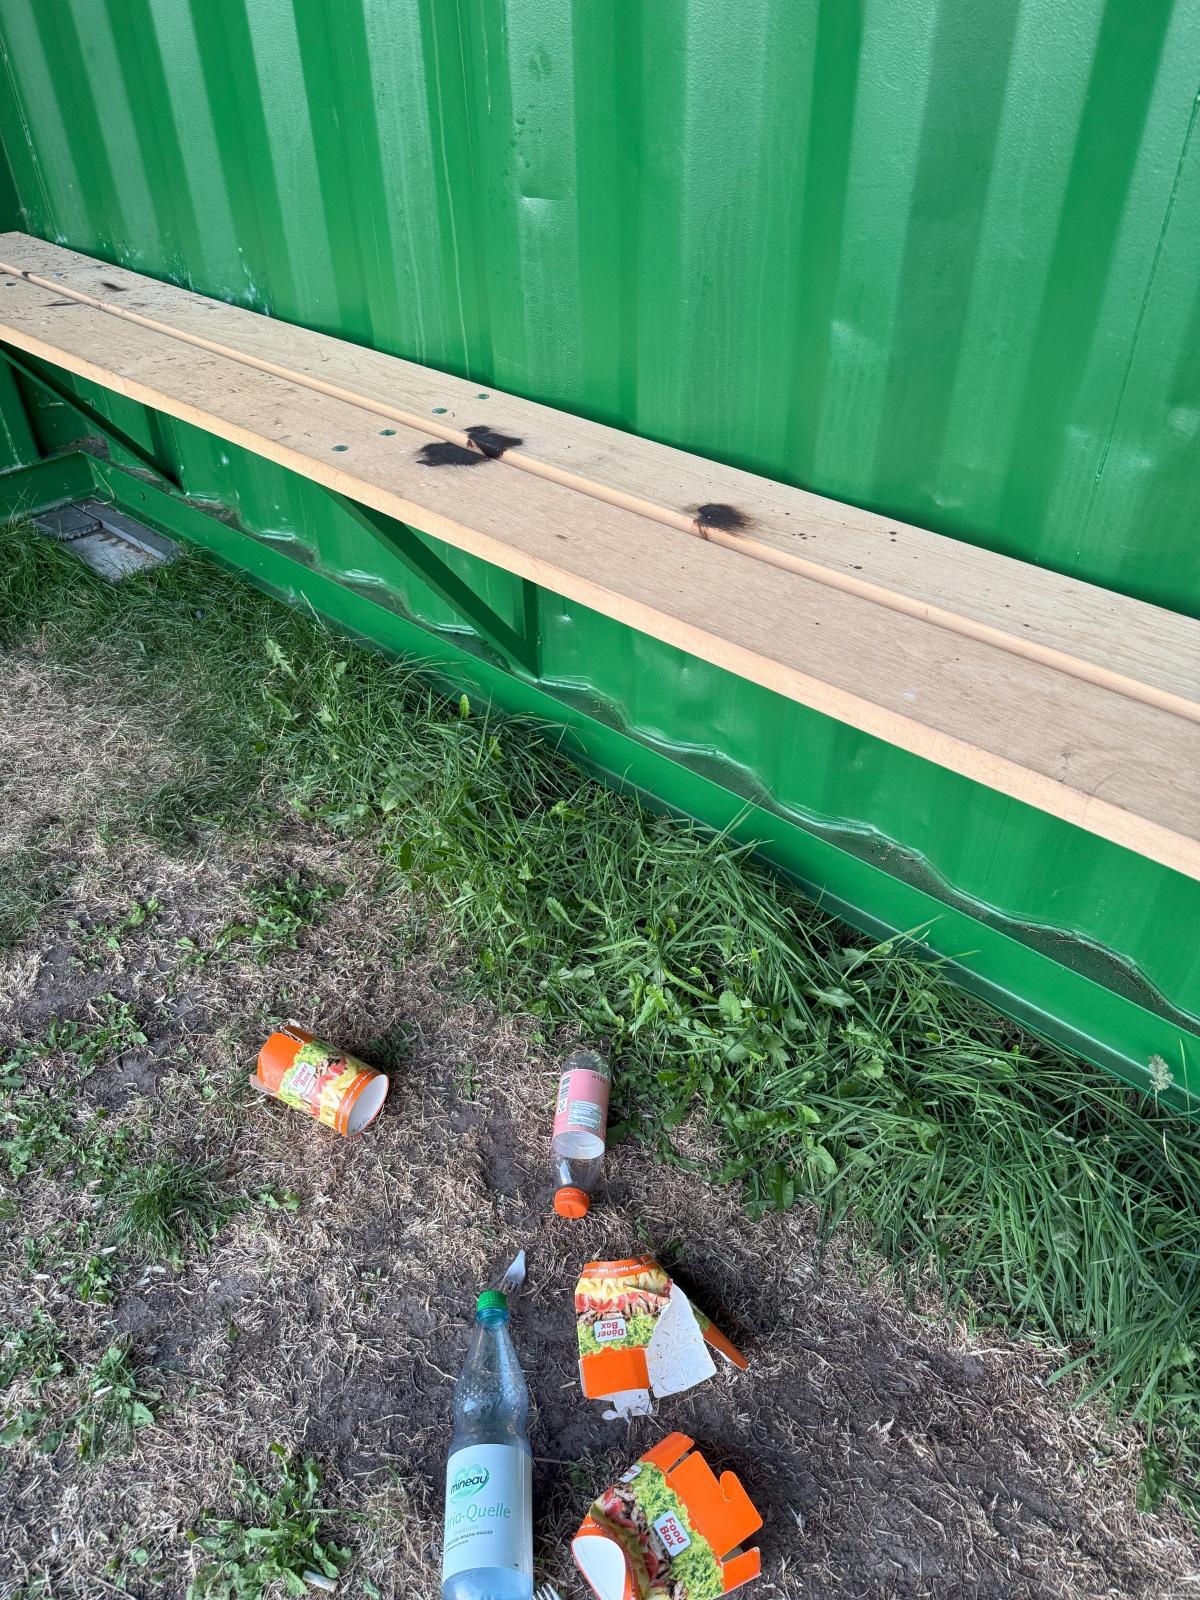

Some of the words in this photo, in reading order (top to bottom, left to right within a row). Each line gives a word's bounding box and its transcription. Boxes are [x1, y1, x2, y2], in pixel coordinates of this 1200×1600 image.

[292, 1064, 308, 1087] Döner
[300, 1070, 312, 1087] Box
[597, 1328, 624, 1338] Döner
[601, 1321, 618, 1330] Box
[450, 1474, 488, 1495] mineau
[659, 1526, 676, 1548] Box
[665, 1516, 687, 1544] Food
